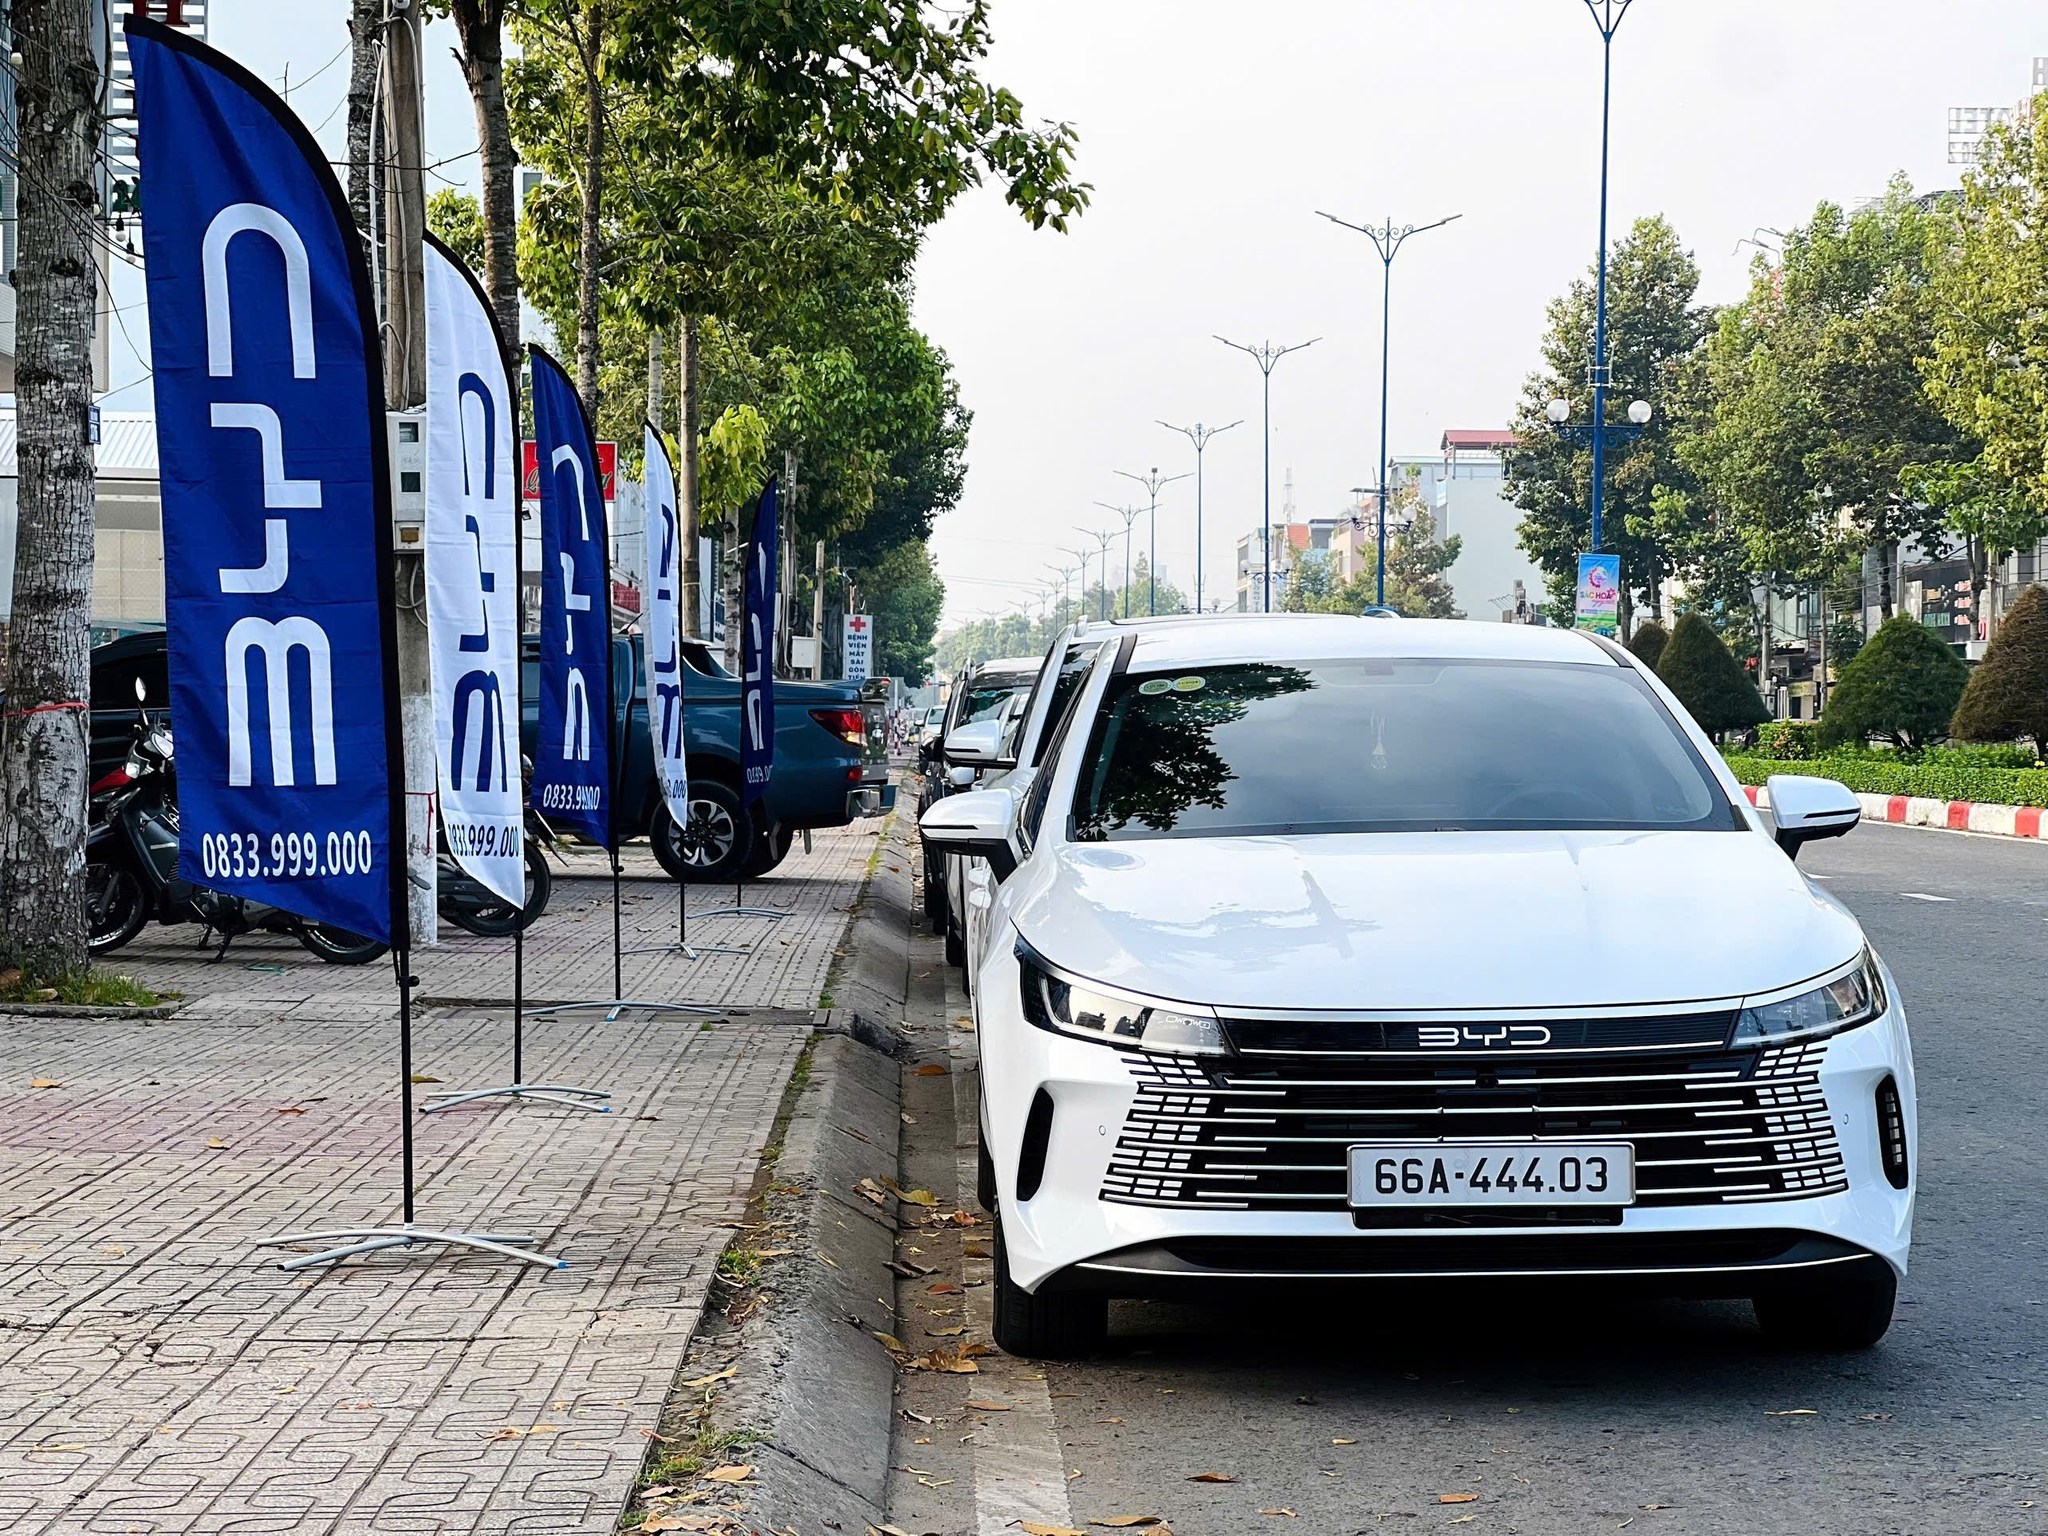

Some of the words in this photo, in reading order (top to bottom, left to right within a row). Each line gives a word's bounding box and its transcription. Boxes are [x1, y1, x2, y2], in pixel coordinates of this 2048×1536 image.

[202, 830, 372, 878] 0833.999.000
[1418, 1025, 1551, 1047] BYD
[1375, 1157, 1608, 1194] 66A-444.03
